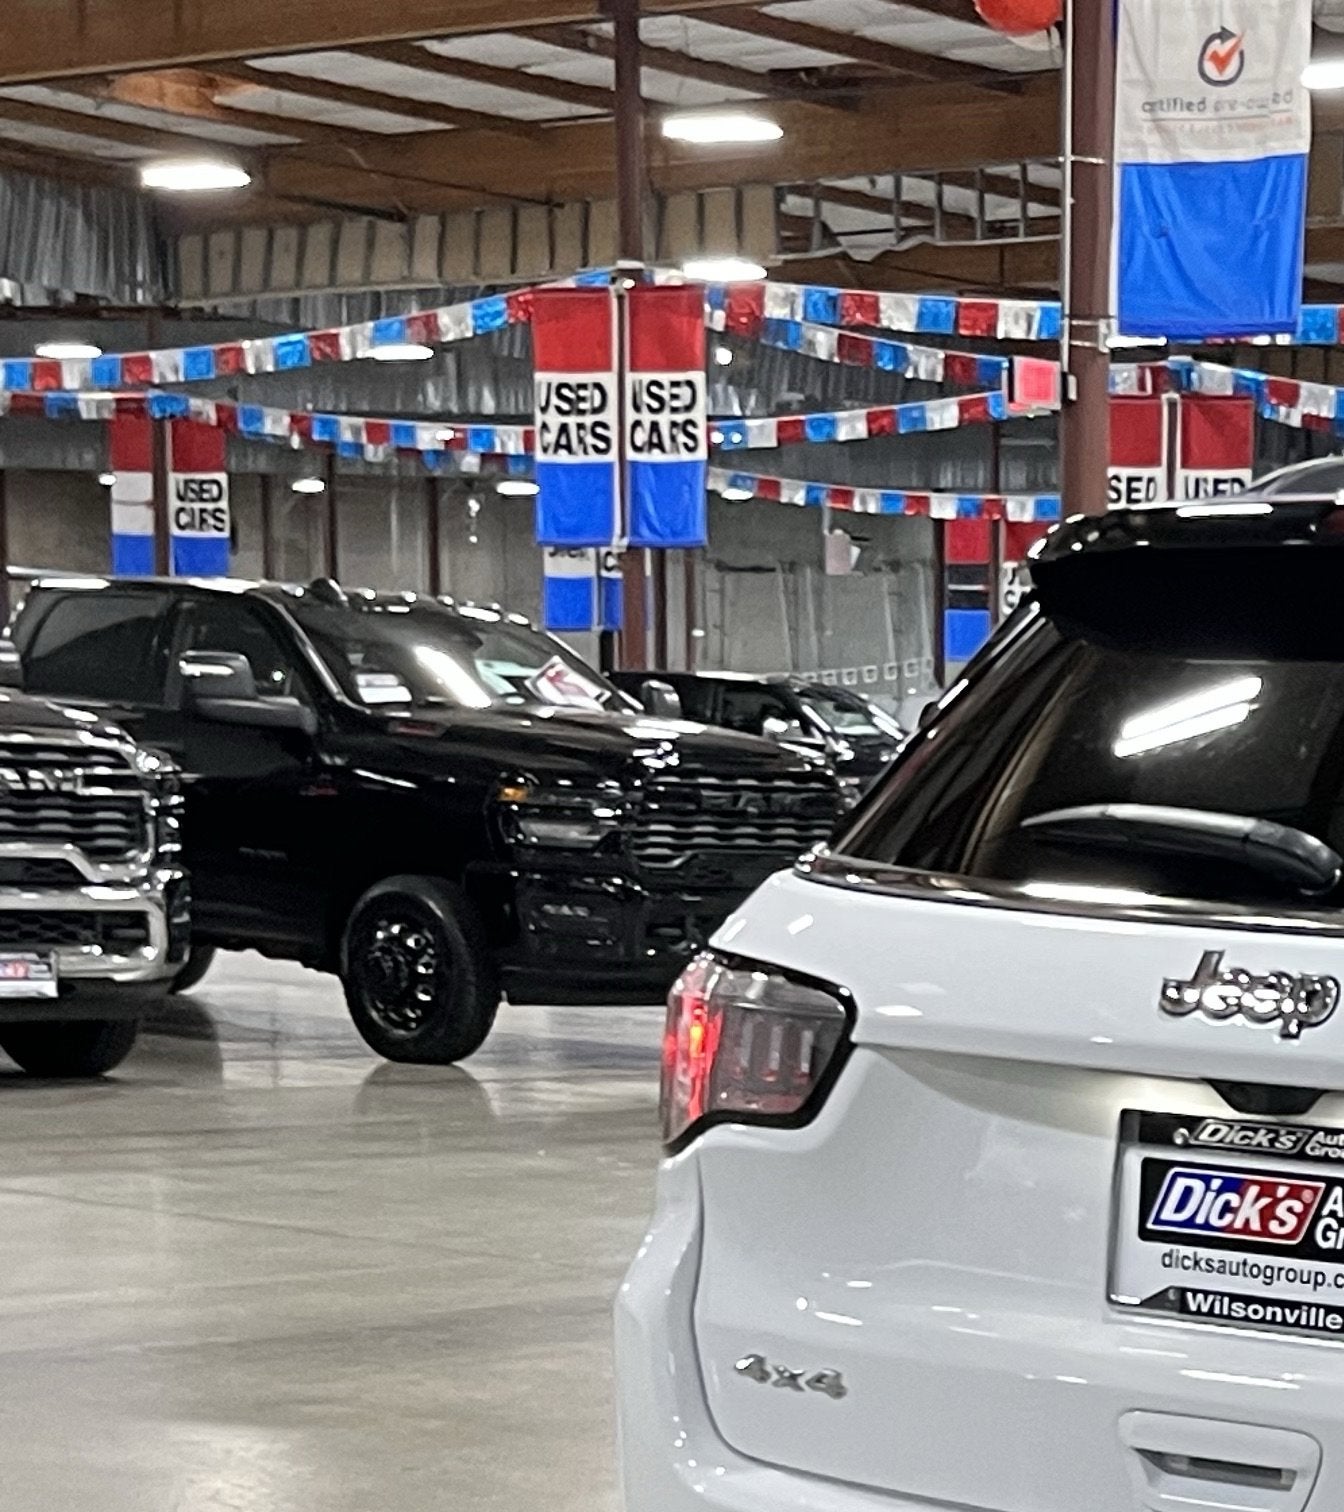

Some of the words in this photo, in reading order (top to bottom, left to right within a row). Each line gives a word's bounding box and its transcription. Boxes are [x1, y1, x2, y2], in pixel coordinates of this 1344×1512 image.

[537, 381, 608, 416] USED
[632, 379, 698, 415] USED
[540, 420, 612, 455] CARS
[630, 418, 699, 453] CARS
[1107, 475, 1157, 503] SED
[1158, 949, 1341, 1040] Jeep
[1200, 1123, 1298, 1150] Dick's
[1159, 1176, 1305, 1236] Dick's
[1185, 1291, 1344, 1331] Wilsonville
